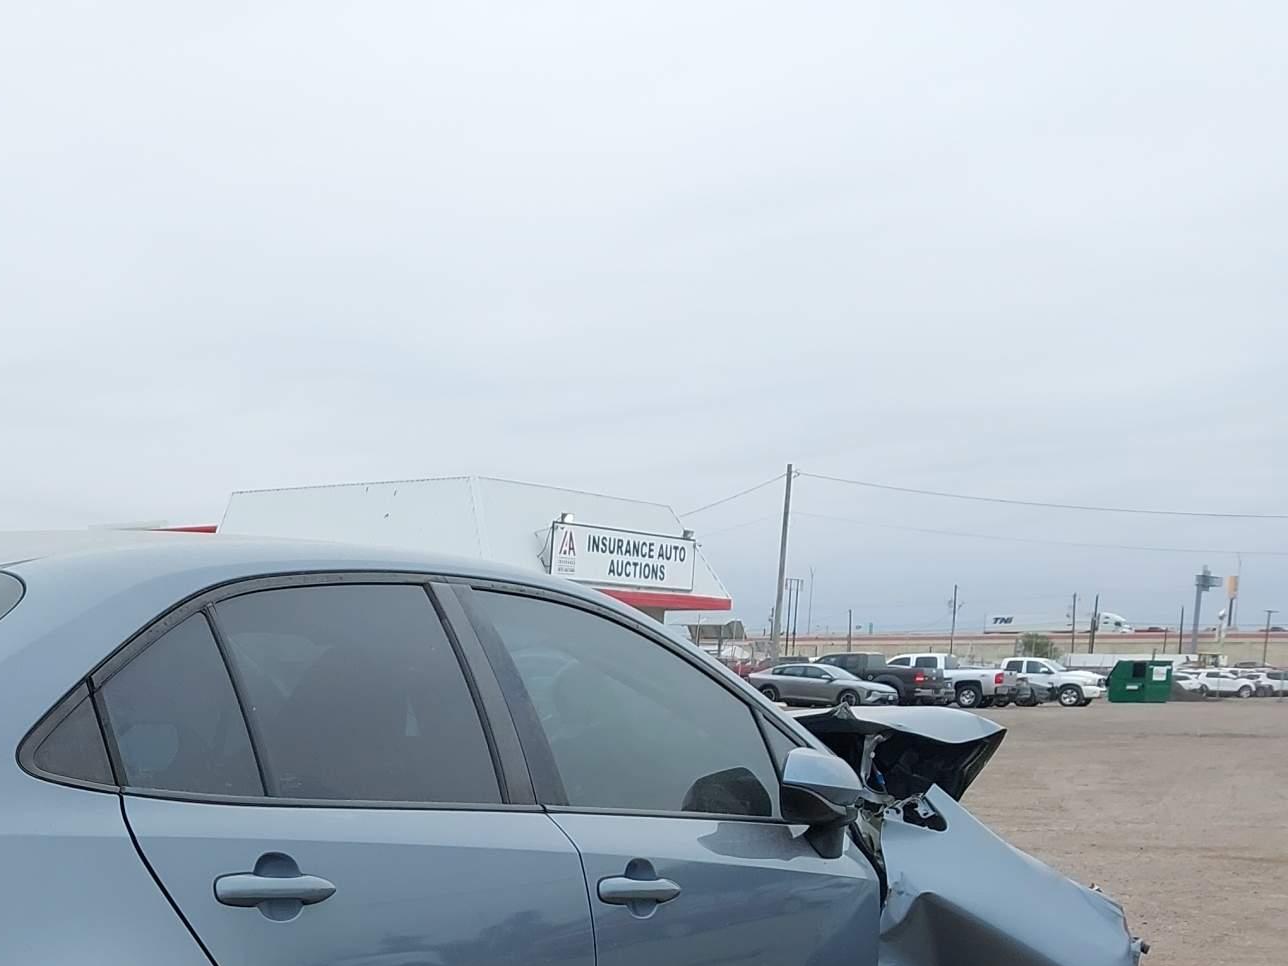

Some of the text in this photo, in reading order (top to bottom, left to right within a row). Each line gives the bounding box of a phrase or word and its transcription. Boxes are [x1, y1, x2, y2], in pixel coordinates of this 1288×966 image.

[587, 534, 686, 562] INSURANCE AUTO
[607, 559, 665, 580] AUCTIONS
